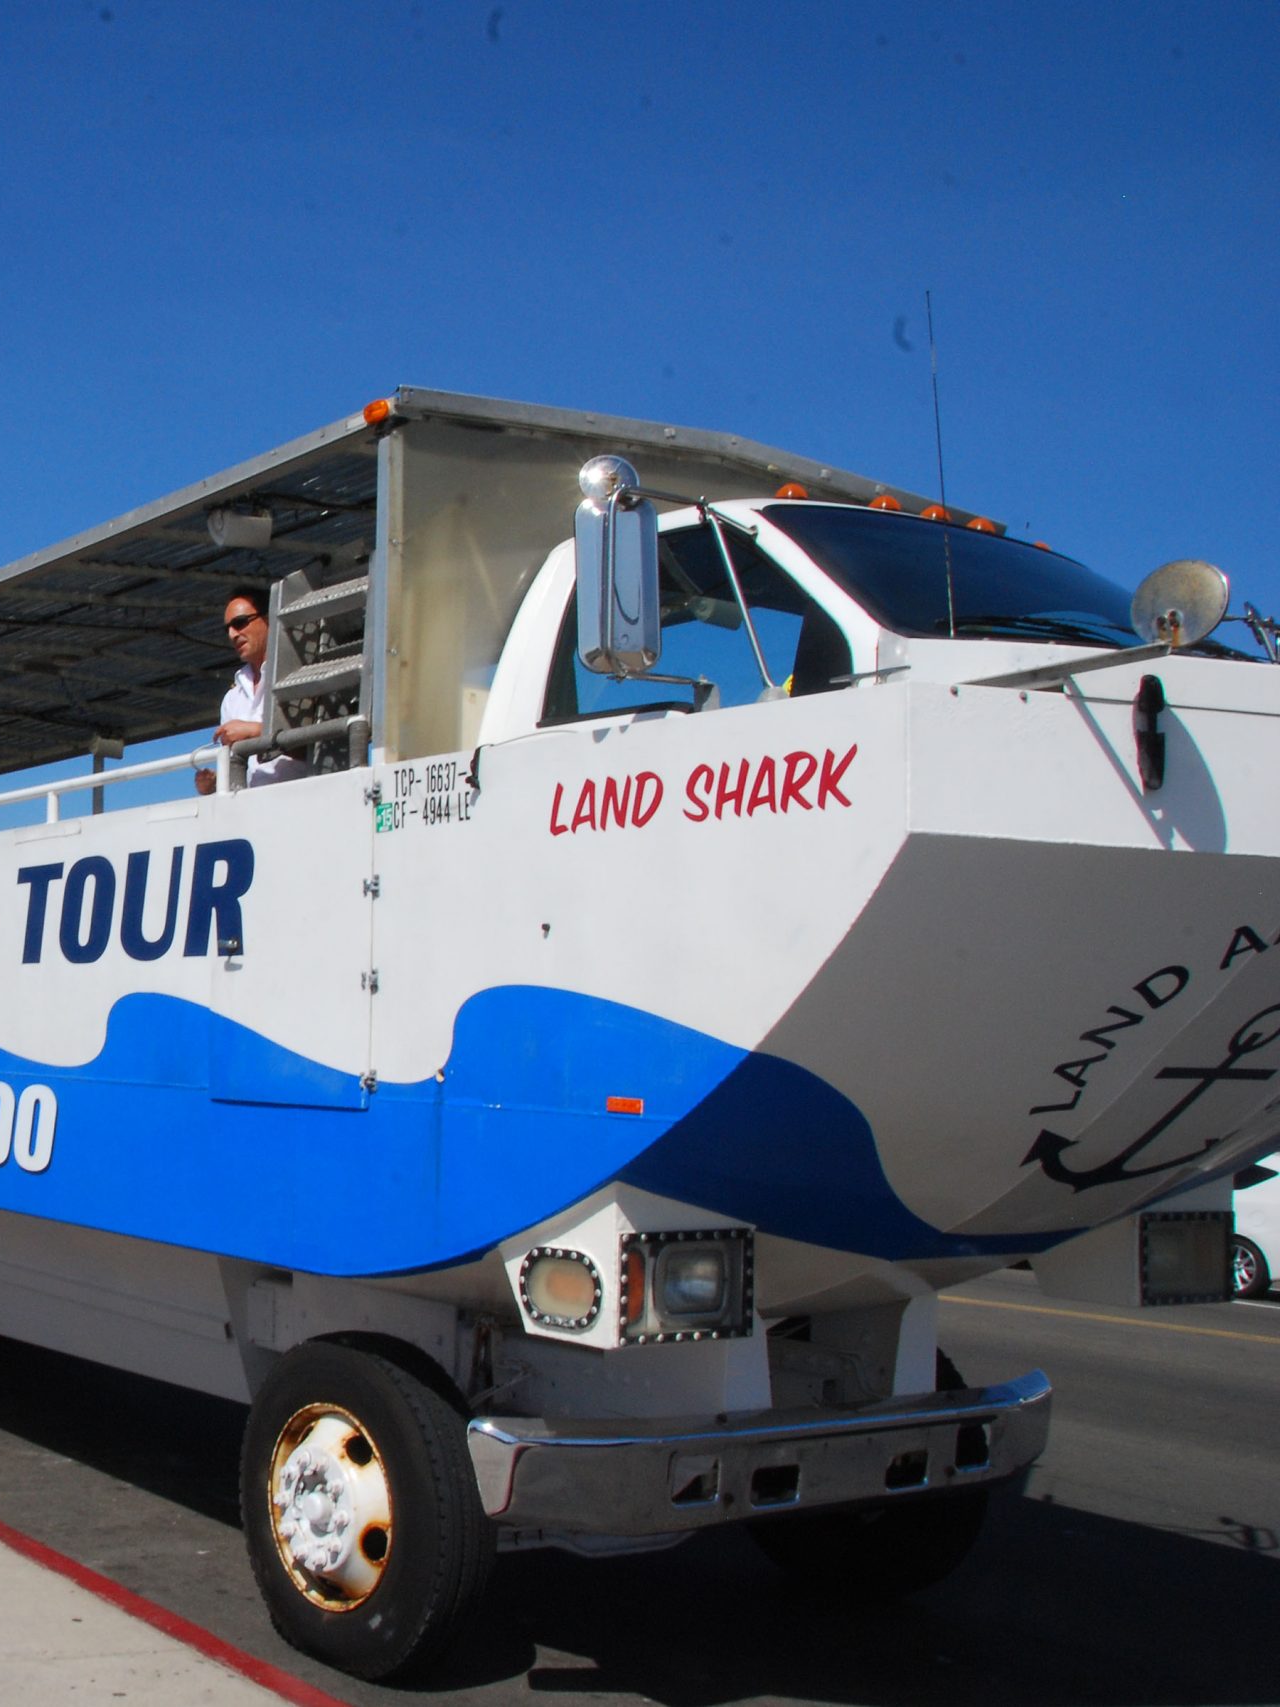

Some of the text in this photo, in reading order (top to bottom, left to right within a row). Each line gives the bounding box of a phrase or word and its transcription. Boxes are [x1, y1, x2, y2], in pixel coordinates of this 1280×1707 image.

[549, 743, 858, 836] LAND SHARK
[16, 838, 255, 965] TOUR
[1028, 925, 1280, 1116] LAND A
